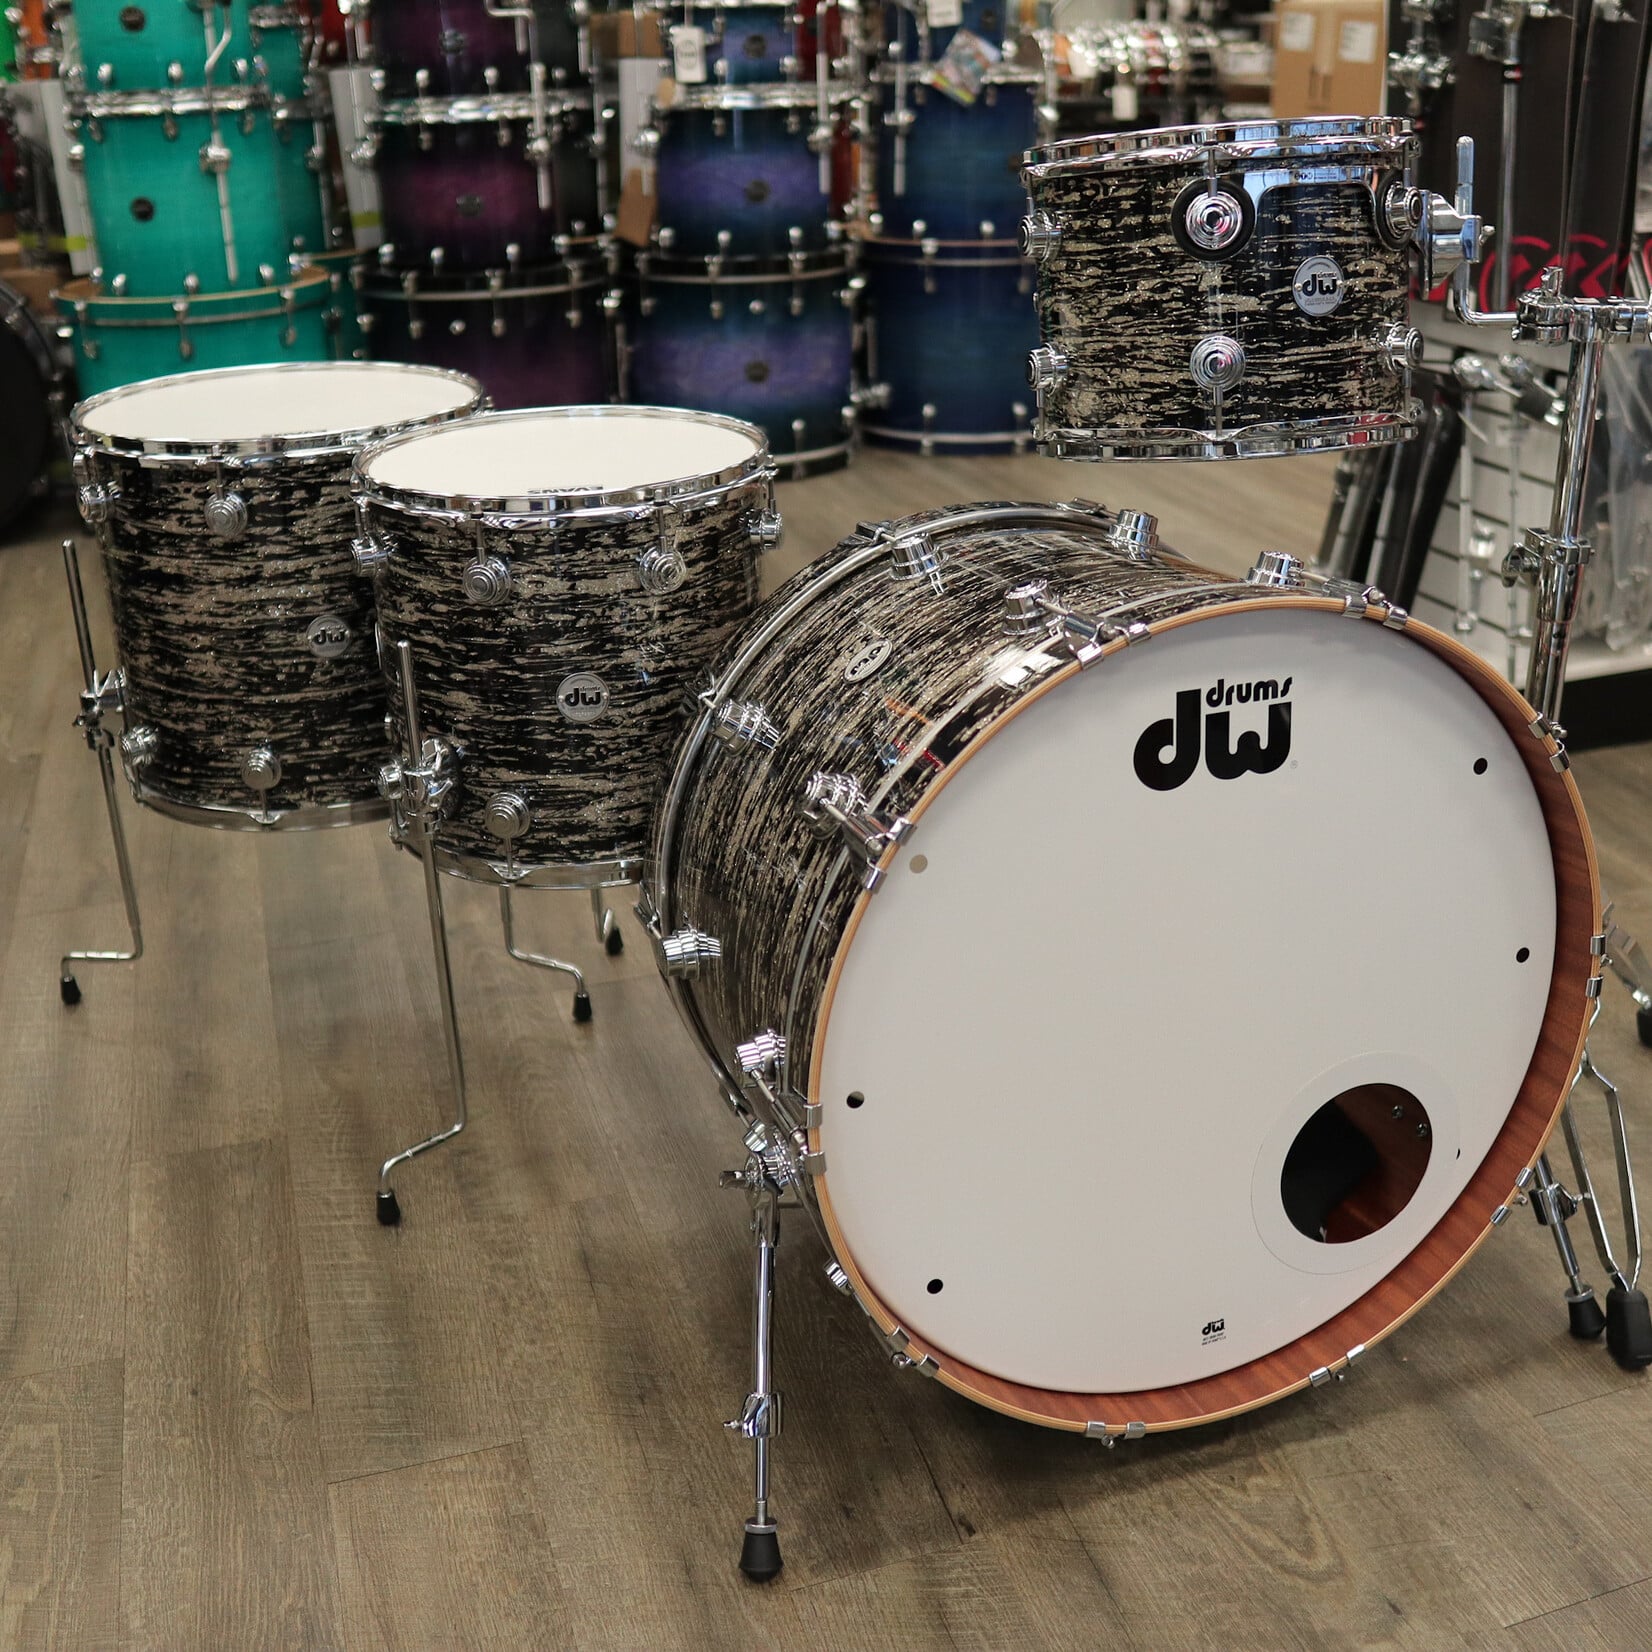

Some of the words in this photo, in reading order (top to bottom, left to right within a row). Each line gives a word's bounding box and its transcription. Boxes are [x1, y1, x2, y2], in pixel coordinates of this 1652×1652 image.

[1302, 272, 1337, 297] dw
[312, 629, 346, 645] dw
[564, 687, 601, 707] dw
[1206, 676, 1293, 708] drums
[1133, 688, 1292, 791] dw
[1201, 1321, 1225, 1336] dw
